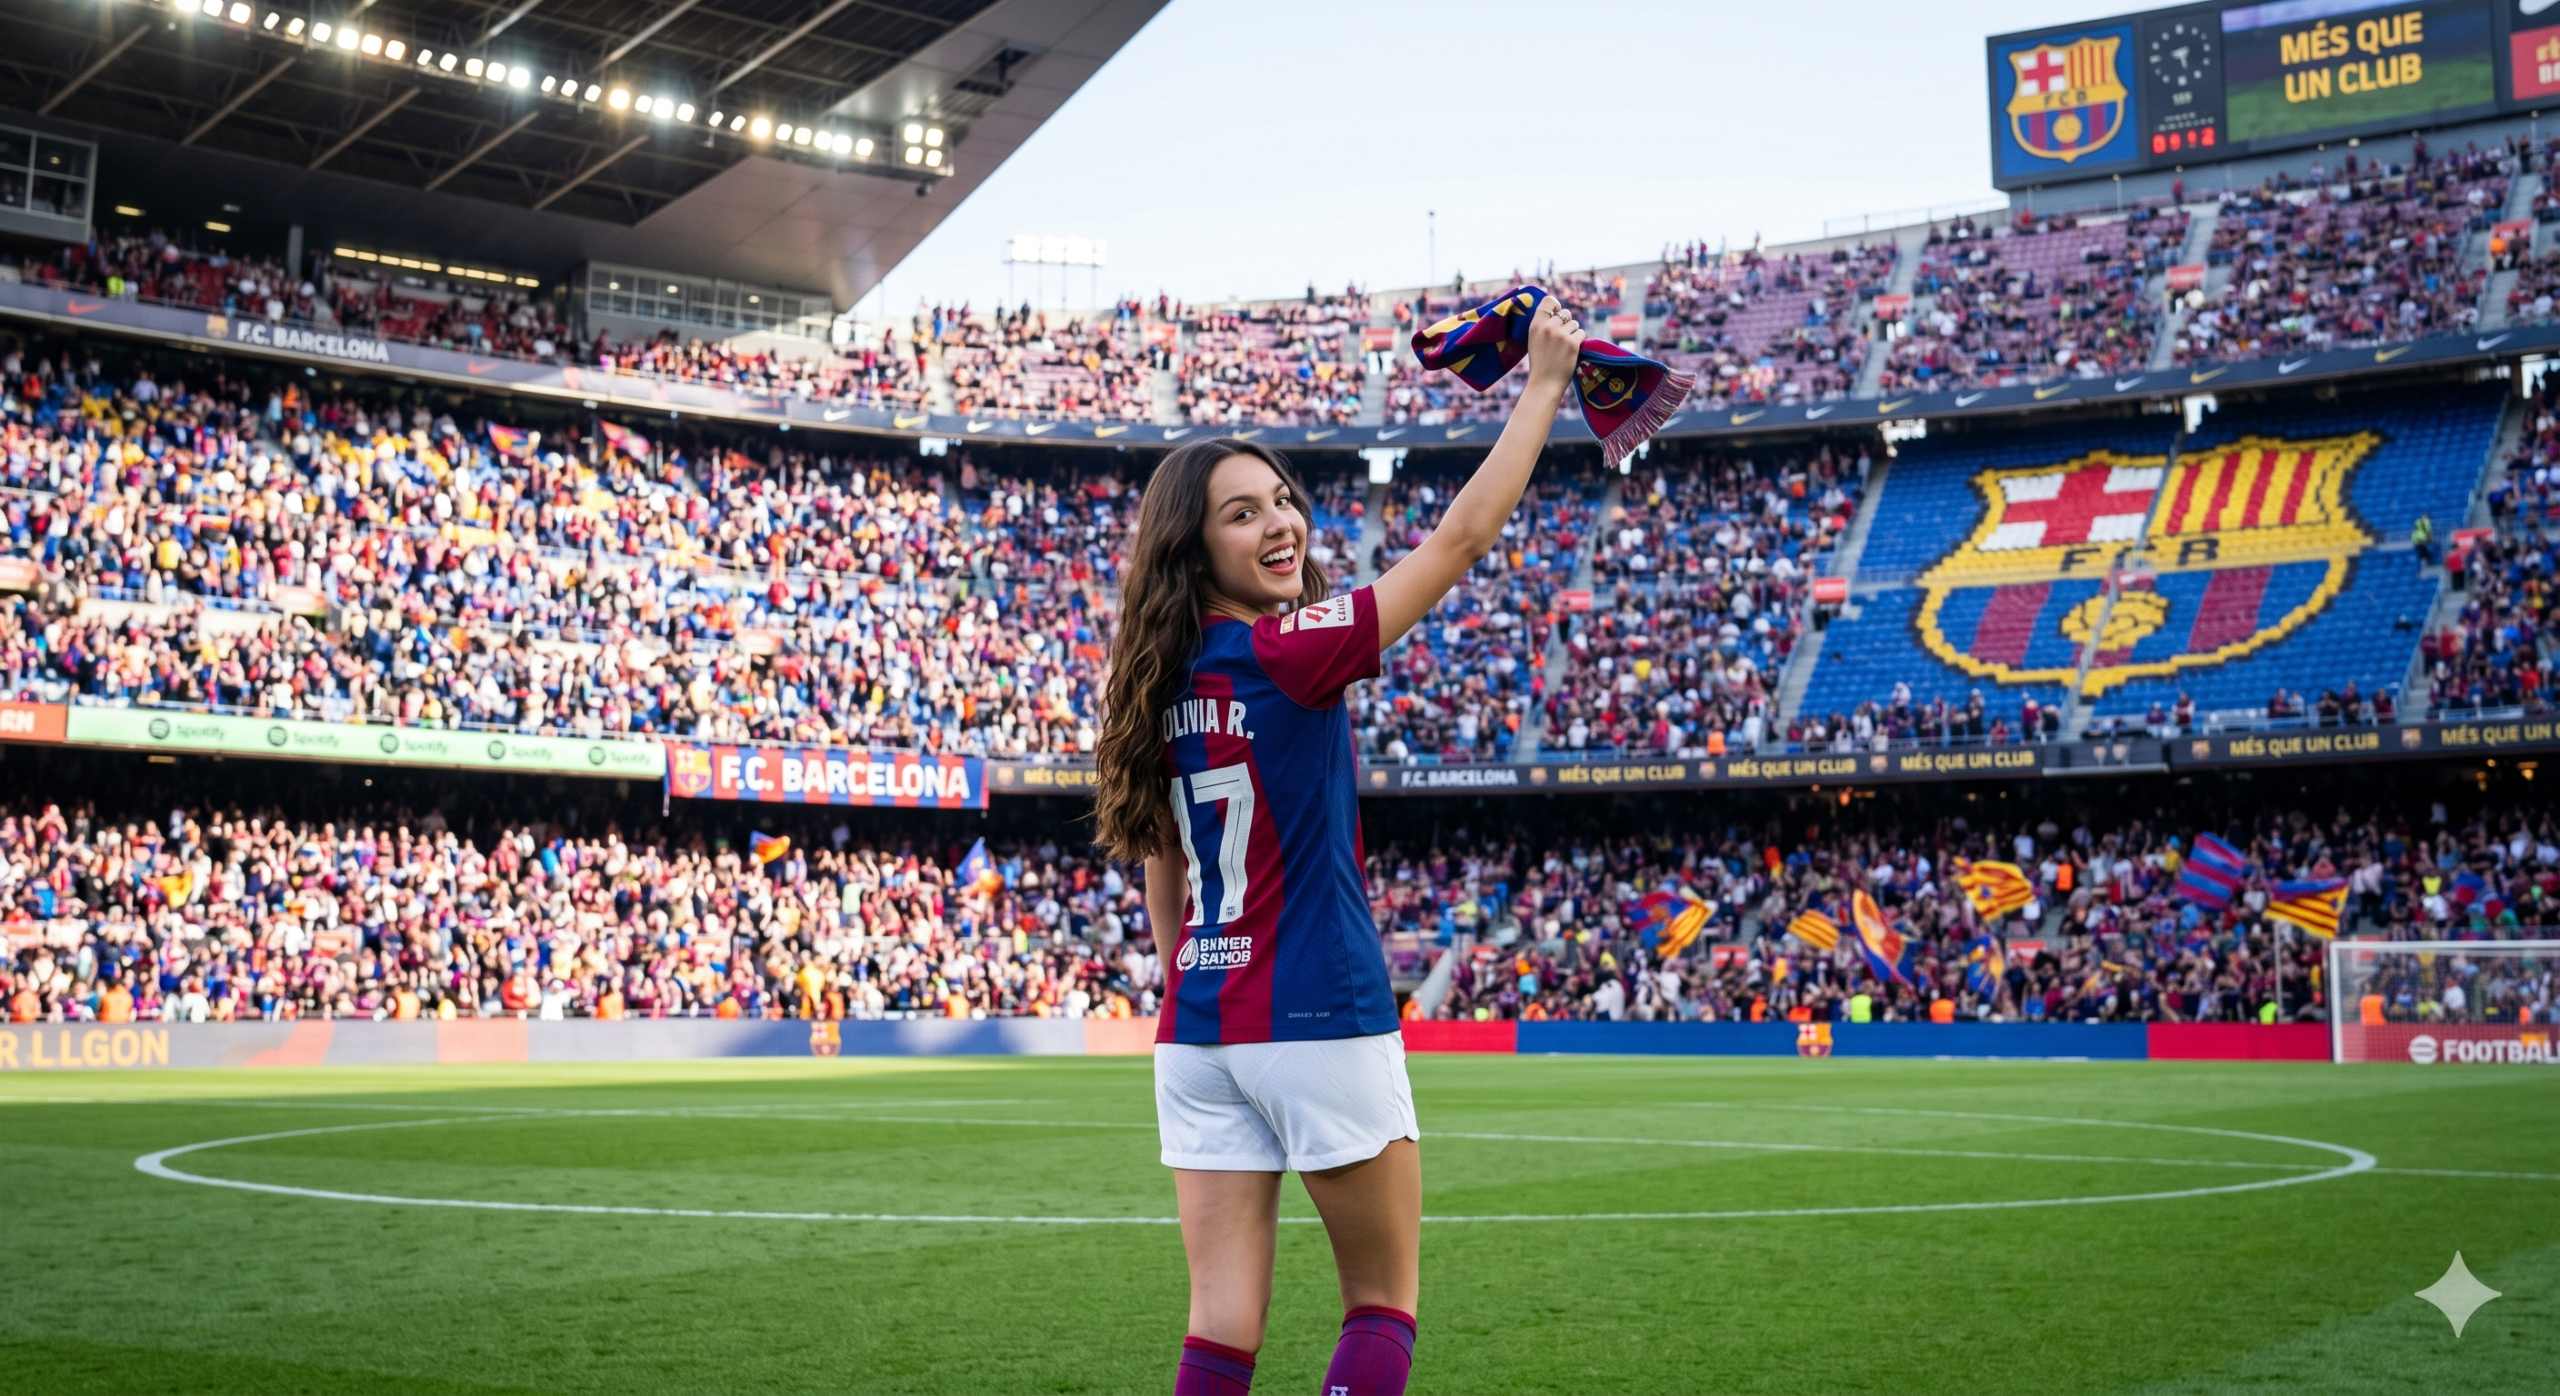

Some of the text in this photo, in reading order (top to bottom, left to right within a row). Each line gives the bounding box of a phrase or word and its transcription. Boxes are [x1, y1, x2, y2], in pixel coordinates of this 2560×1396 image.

[2280, 11, 2424, 65] MÉS QUE
[2285, 53, 2423, 103] UN CLUB
[237, 321, 390, 363] F.C. BARCELONA
[1162, 698, 1255, 743] OLIVIA R.
[2229, 732, 2380, 758] MÉS QUE UN CLUB
[2441, 724, 2480, 746] MÉS
[2483, 725, 2521, 747] QUE
[2524, 723, 2552, 741] UN
[1558, 764, 1686, 785] MÉS QUE UN CLUB
[1728, 758, 1857, 779] MÉS QUE UN CLUB
[1900, 750, 2035, 773] MÉS QUE UN CLUB
[720, 754, 971, 799] F.C. BARCELONA
[1401, 768, 1518, 787] F.C. BARCELONA
[1169, 762, 1255, 926] 17
[2443, 1039, 2560, 1064] FOOTBAL
